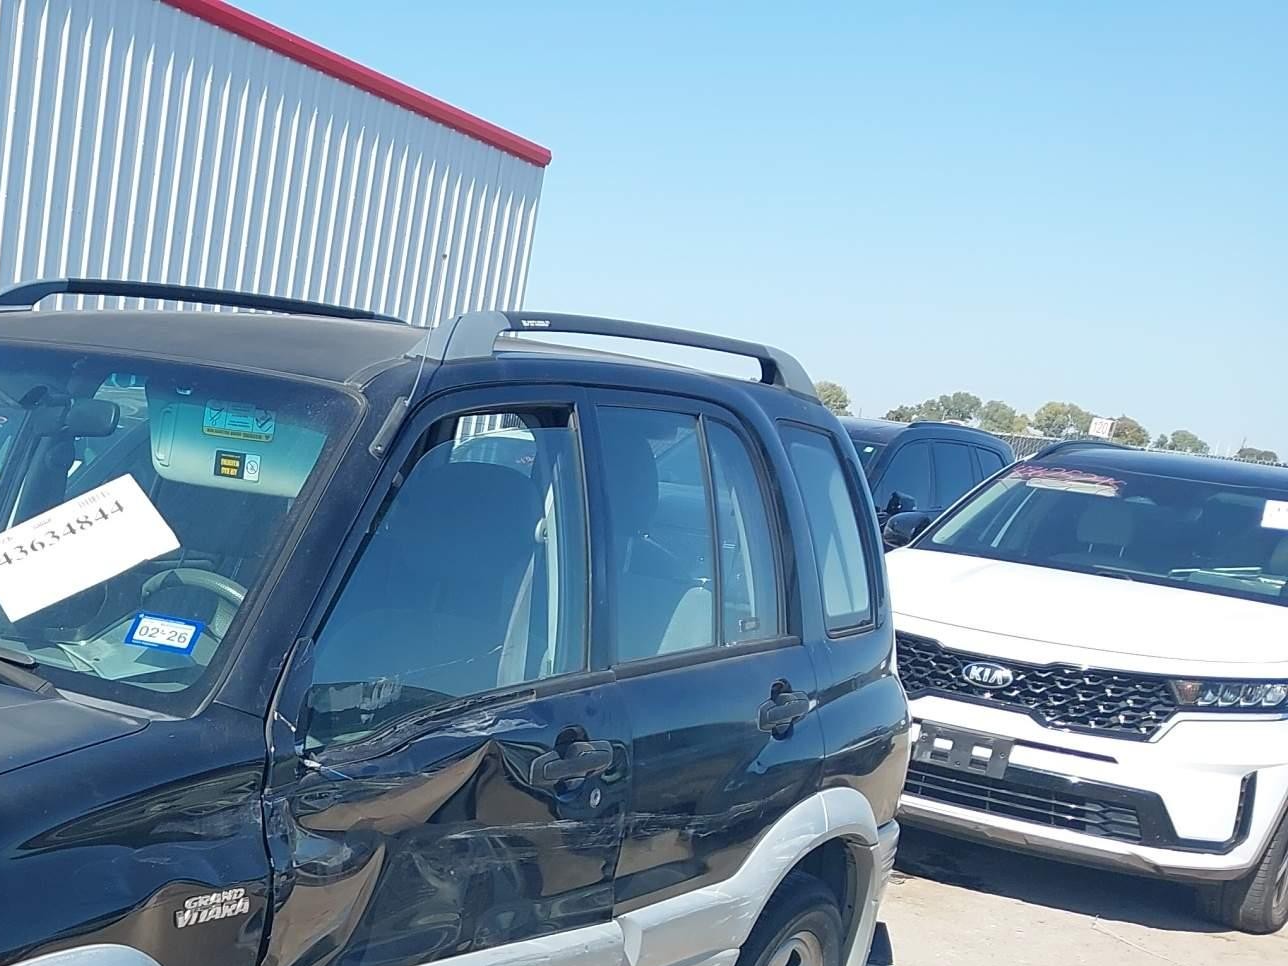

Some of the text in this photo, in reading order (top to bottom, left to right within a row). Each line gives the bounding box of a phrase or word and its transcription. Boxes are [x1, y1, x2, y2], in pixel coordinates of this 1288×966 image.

[969, 665, 1003, 685] KIA
[184, 887, 246, 910] GRAND
[175, 896, 250, 929] VITARA
